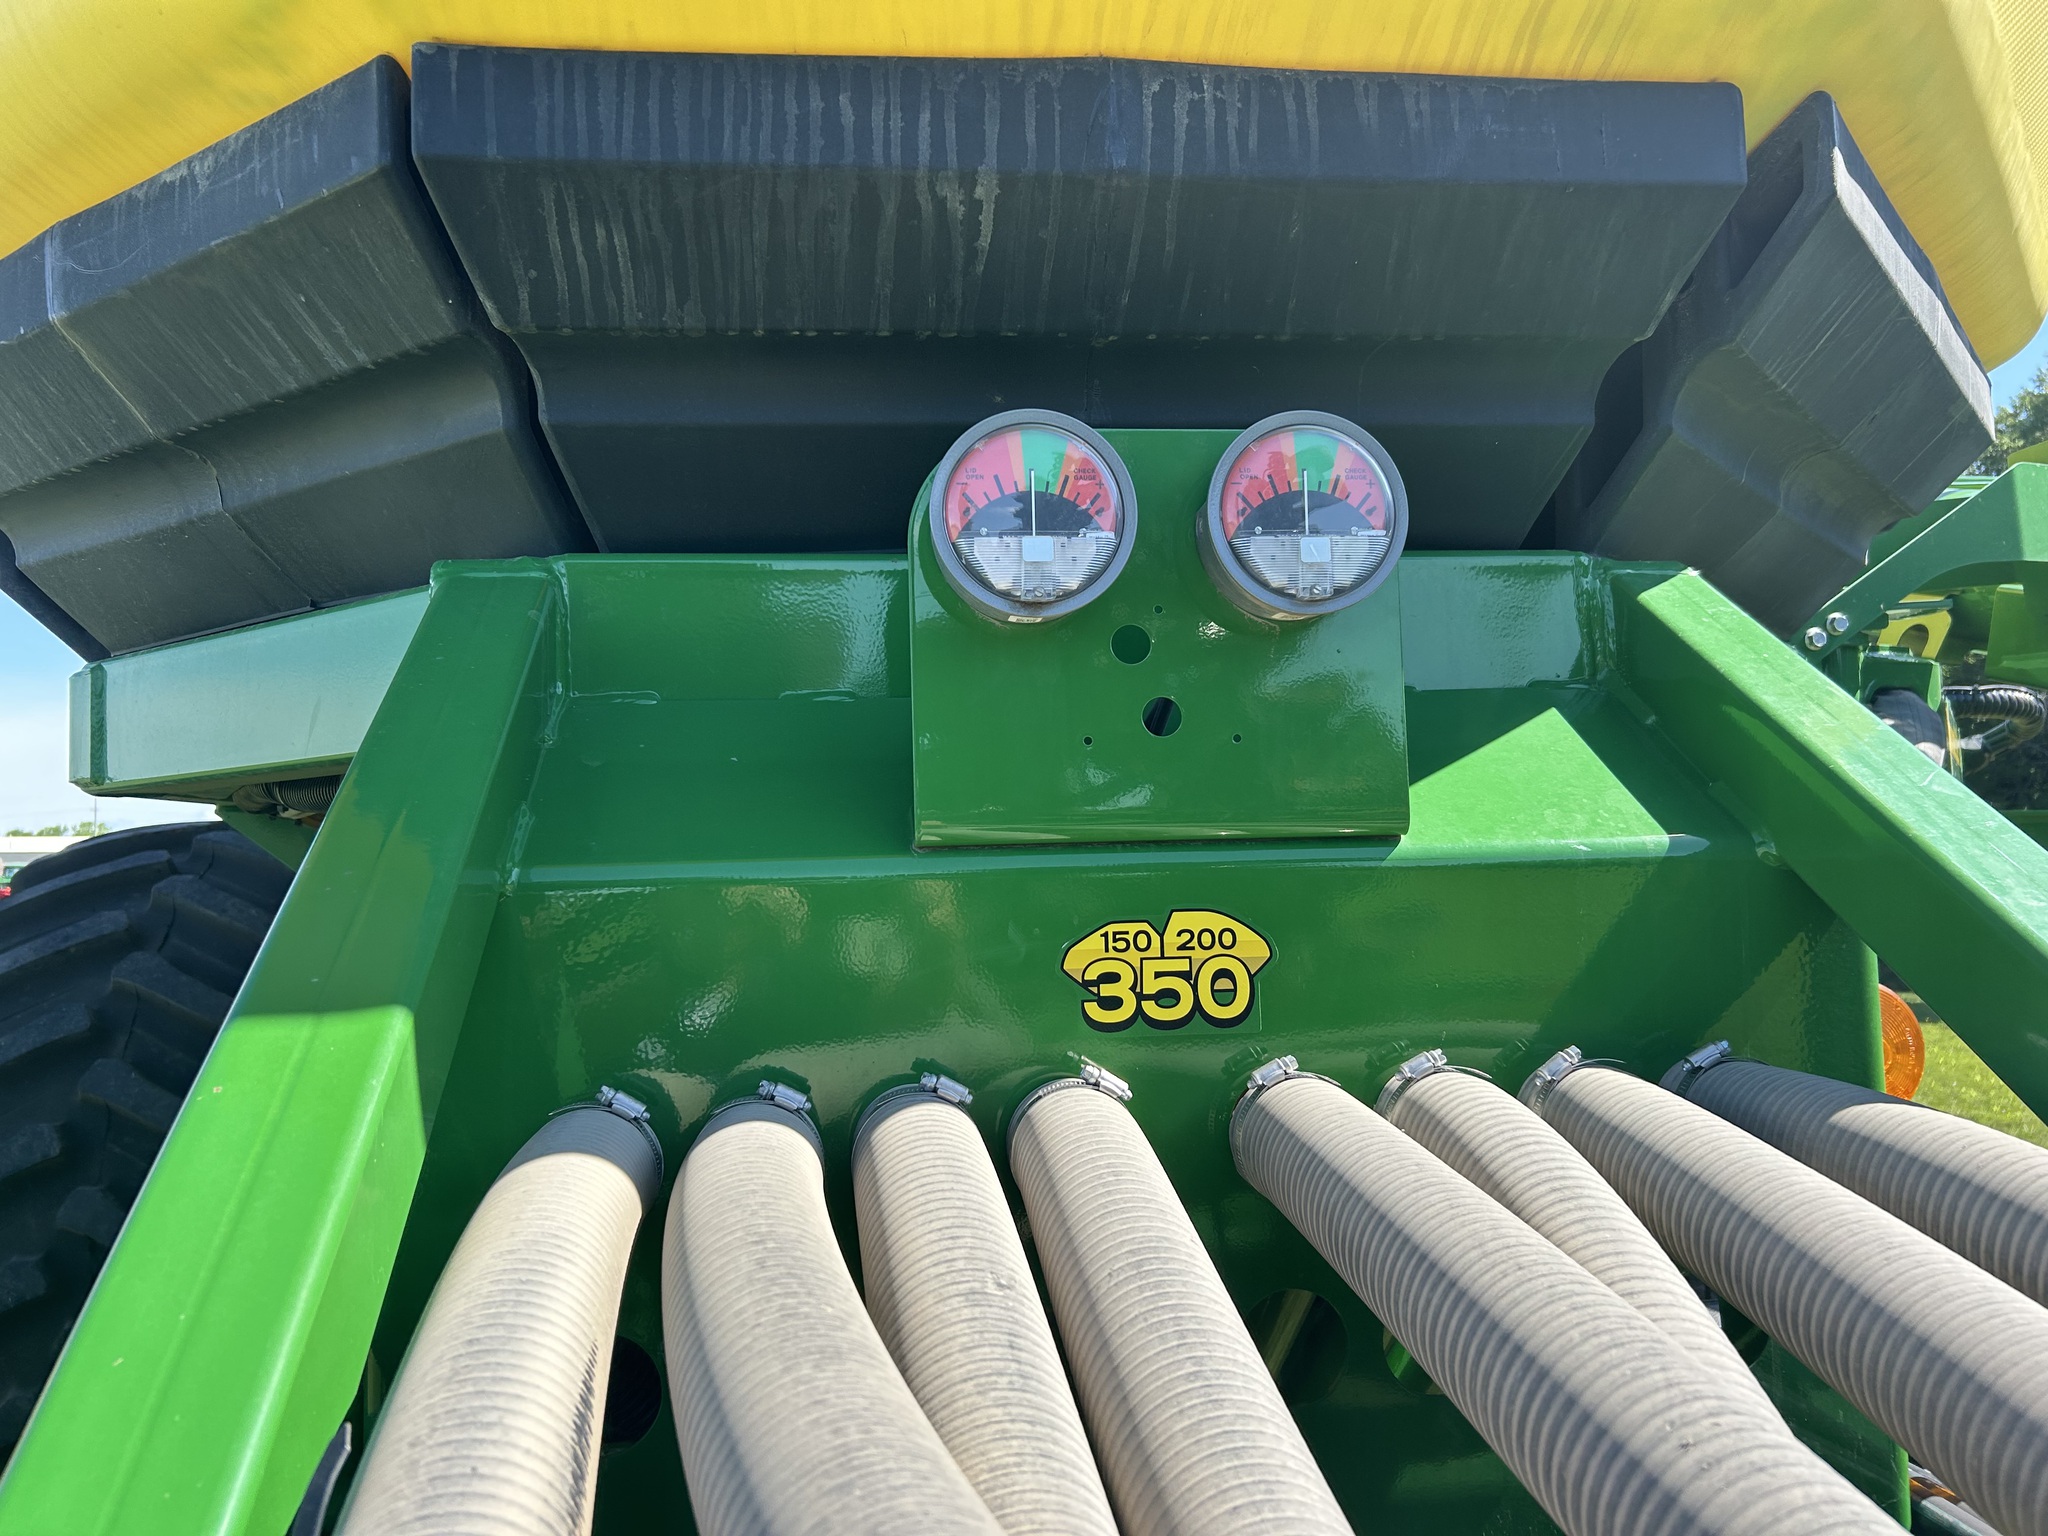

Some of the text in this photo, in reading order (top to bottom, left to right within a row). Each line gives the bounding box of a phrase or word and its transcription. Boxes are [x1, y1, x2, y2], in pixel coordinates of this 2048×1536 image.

[1100, 929, 1152, 953] 150
[1175, 927, 1237, 951] 200
[1082, 954, 1254, 1030] 350
